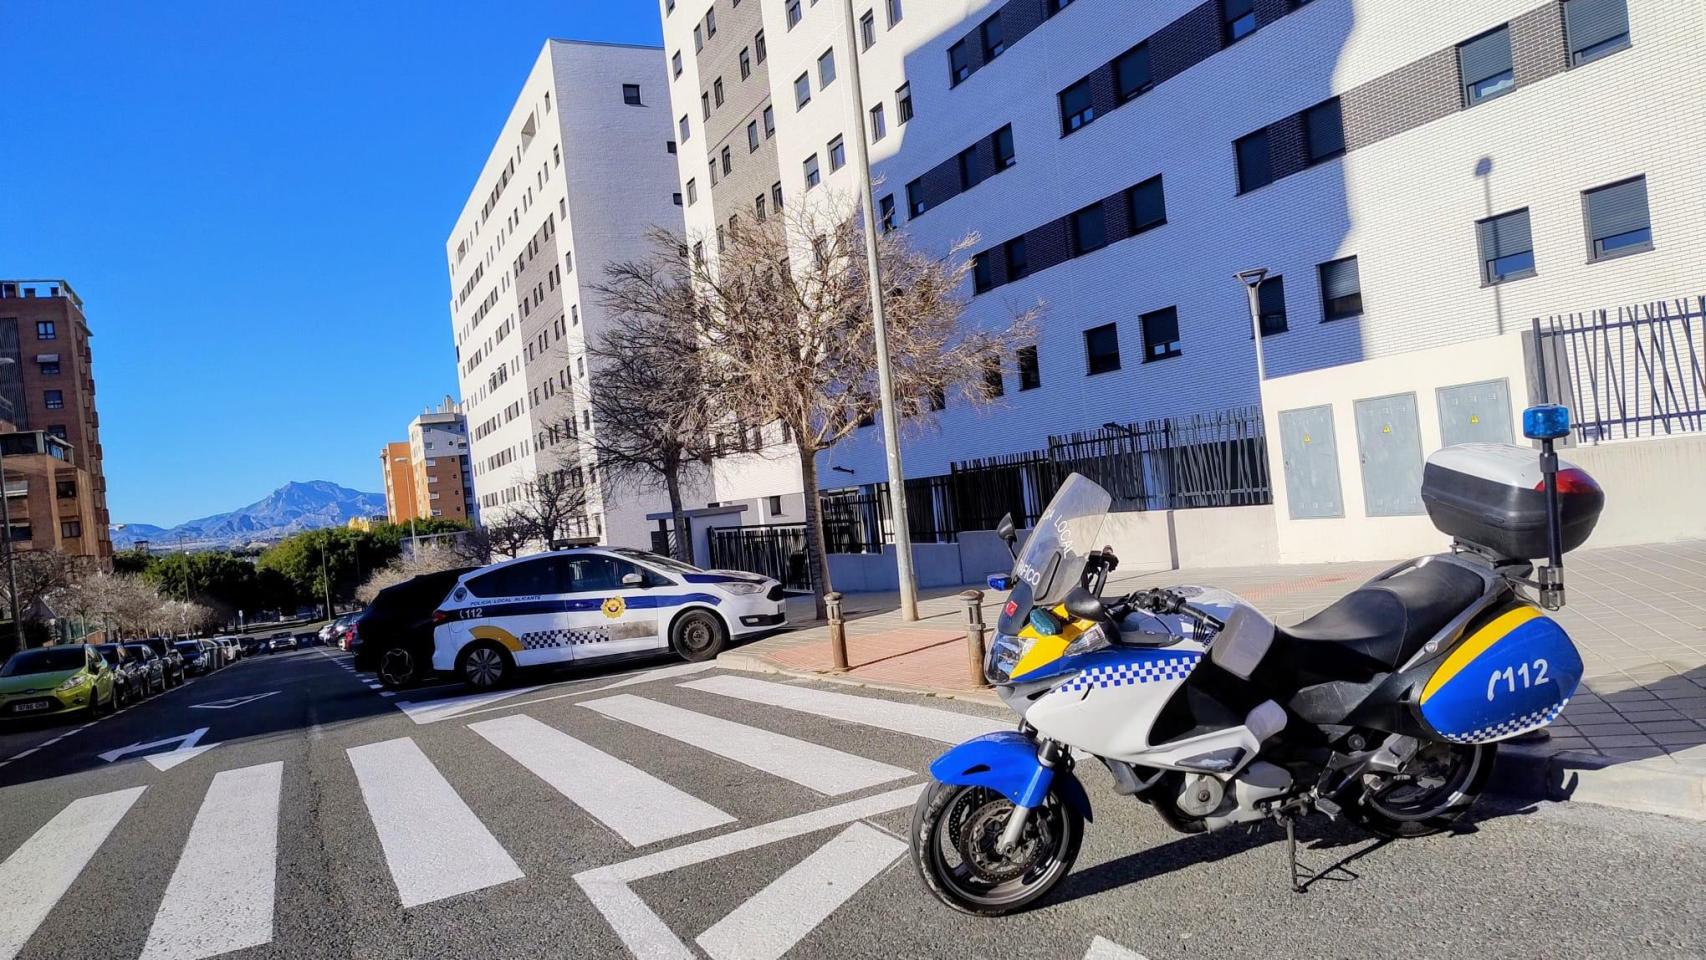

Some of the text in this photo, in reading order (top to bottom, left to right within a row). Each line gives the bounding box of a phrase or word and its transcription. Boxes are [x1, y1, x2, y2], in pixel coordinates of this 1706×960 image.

[1054, 514, 1074, 559] LOCAL
[465, 607, 483, 619] 112
[1502, 658, 1550, 692] 112
